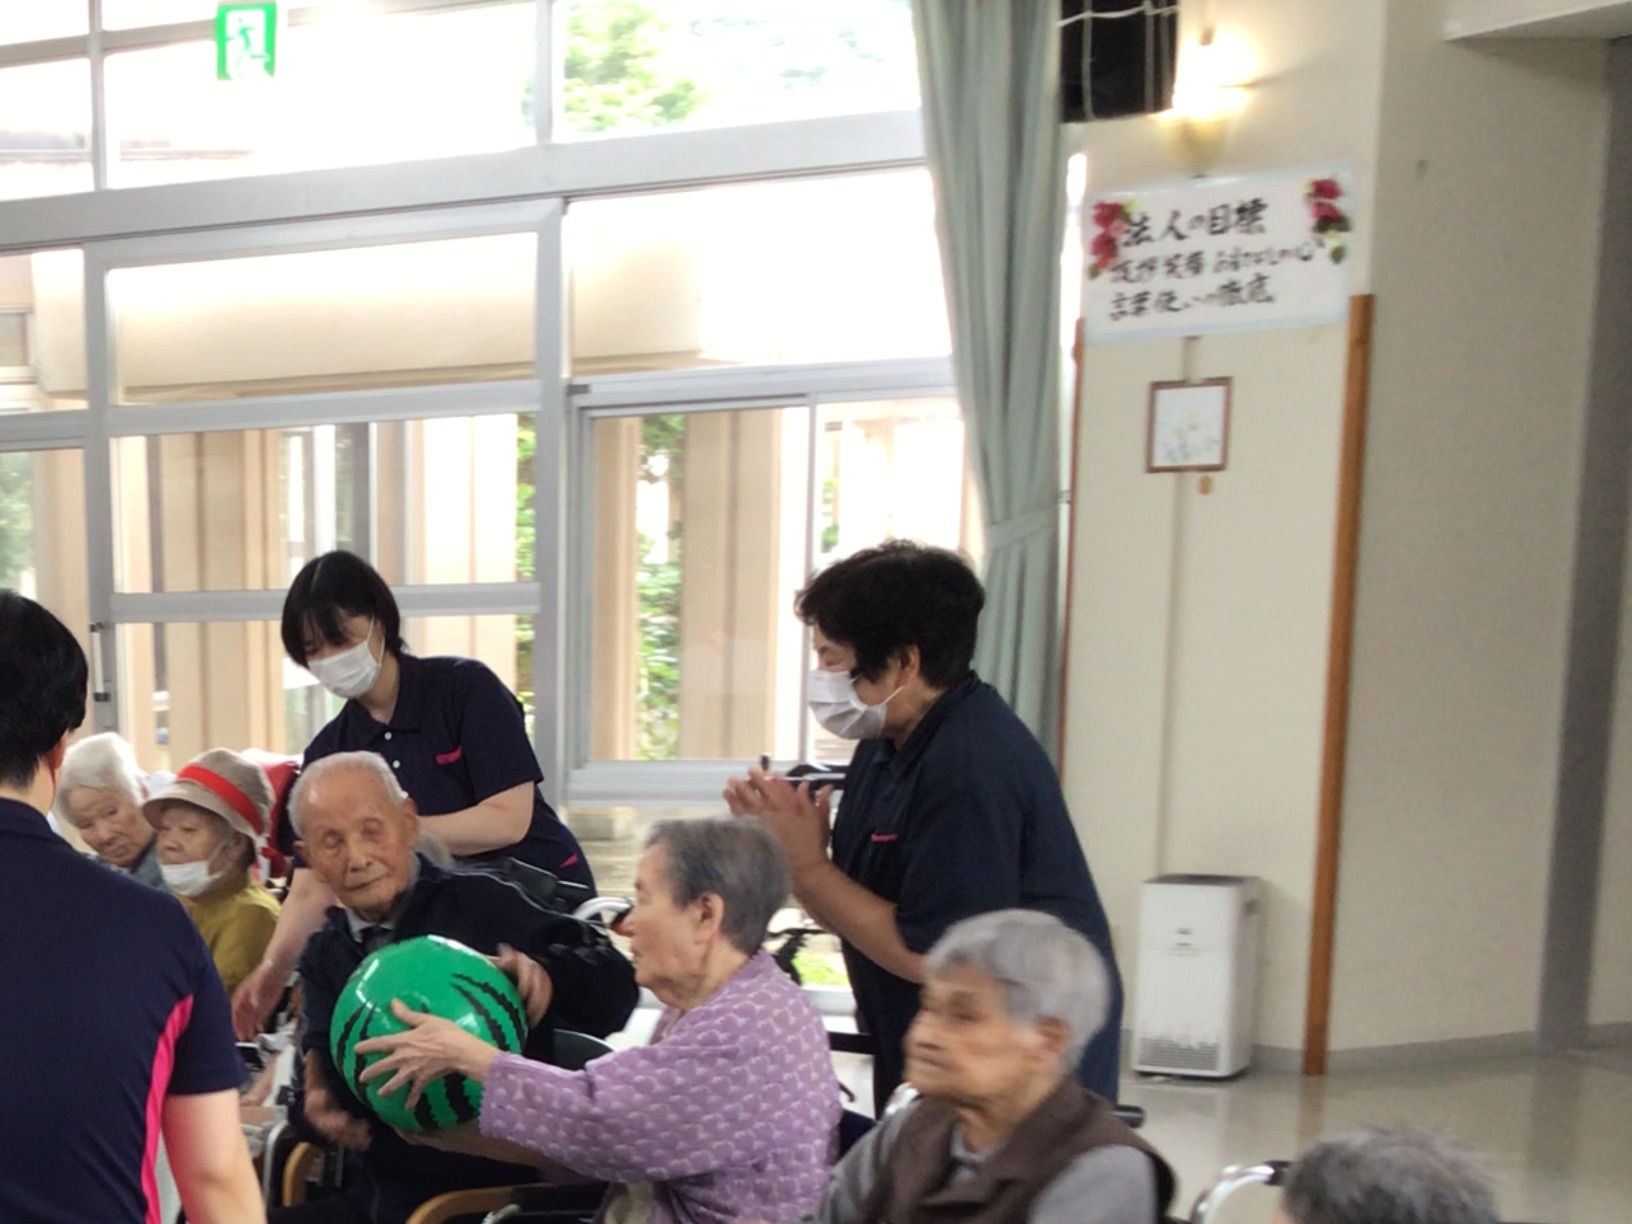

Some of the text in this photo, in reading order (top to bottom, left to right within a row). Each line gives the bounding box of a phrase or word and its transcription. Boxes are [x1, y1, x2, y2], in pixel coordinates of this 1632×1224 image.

[1121, 197, 1269, 248] 法人の目標
